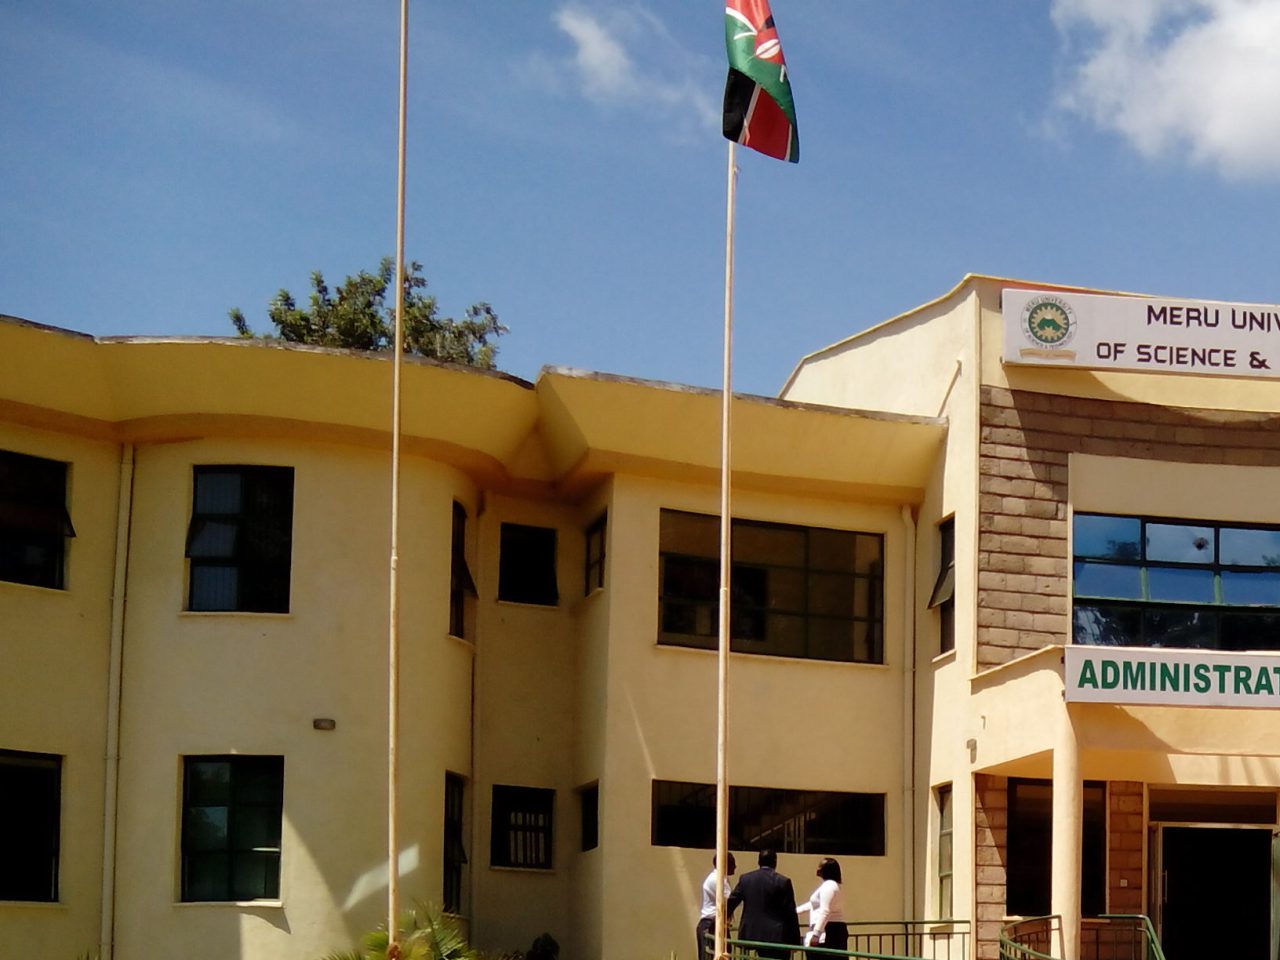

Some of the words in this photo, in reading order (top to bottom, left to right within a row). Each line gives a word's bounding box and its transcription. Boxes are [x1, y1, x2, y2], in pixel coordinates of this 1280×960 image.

[1147, 304, 1220, 328] MERU
[1096, 342, 1127, 362] OF
[1136, 344, 1237, 368] SCIENCE
[1248, 351, 1271, 370] &
